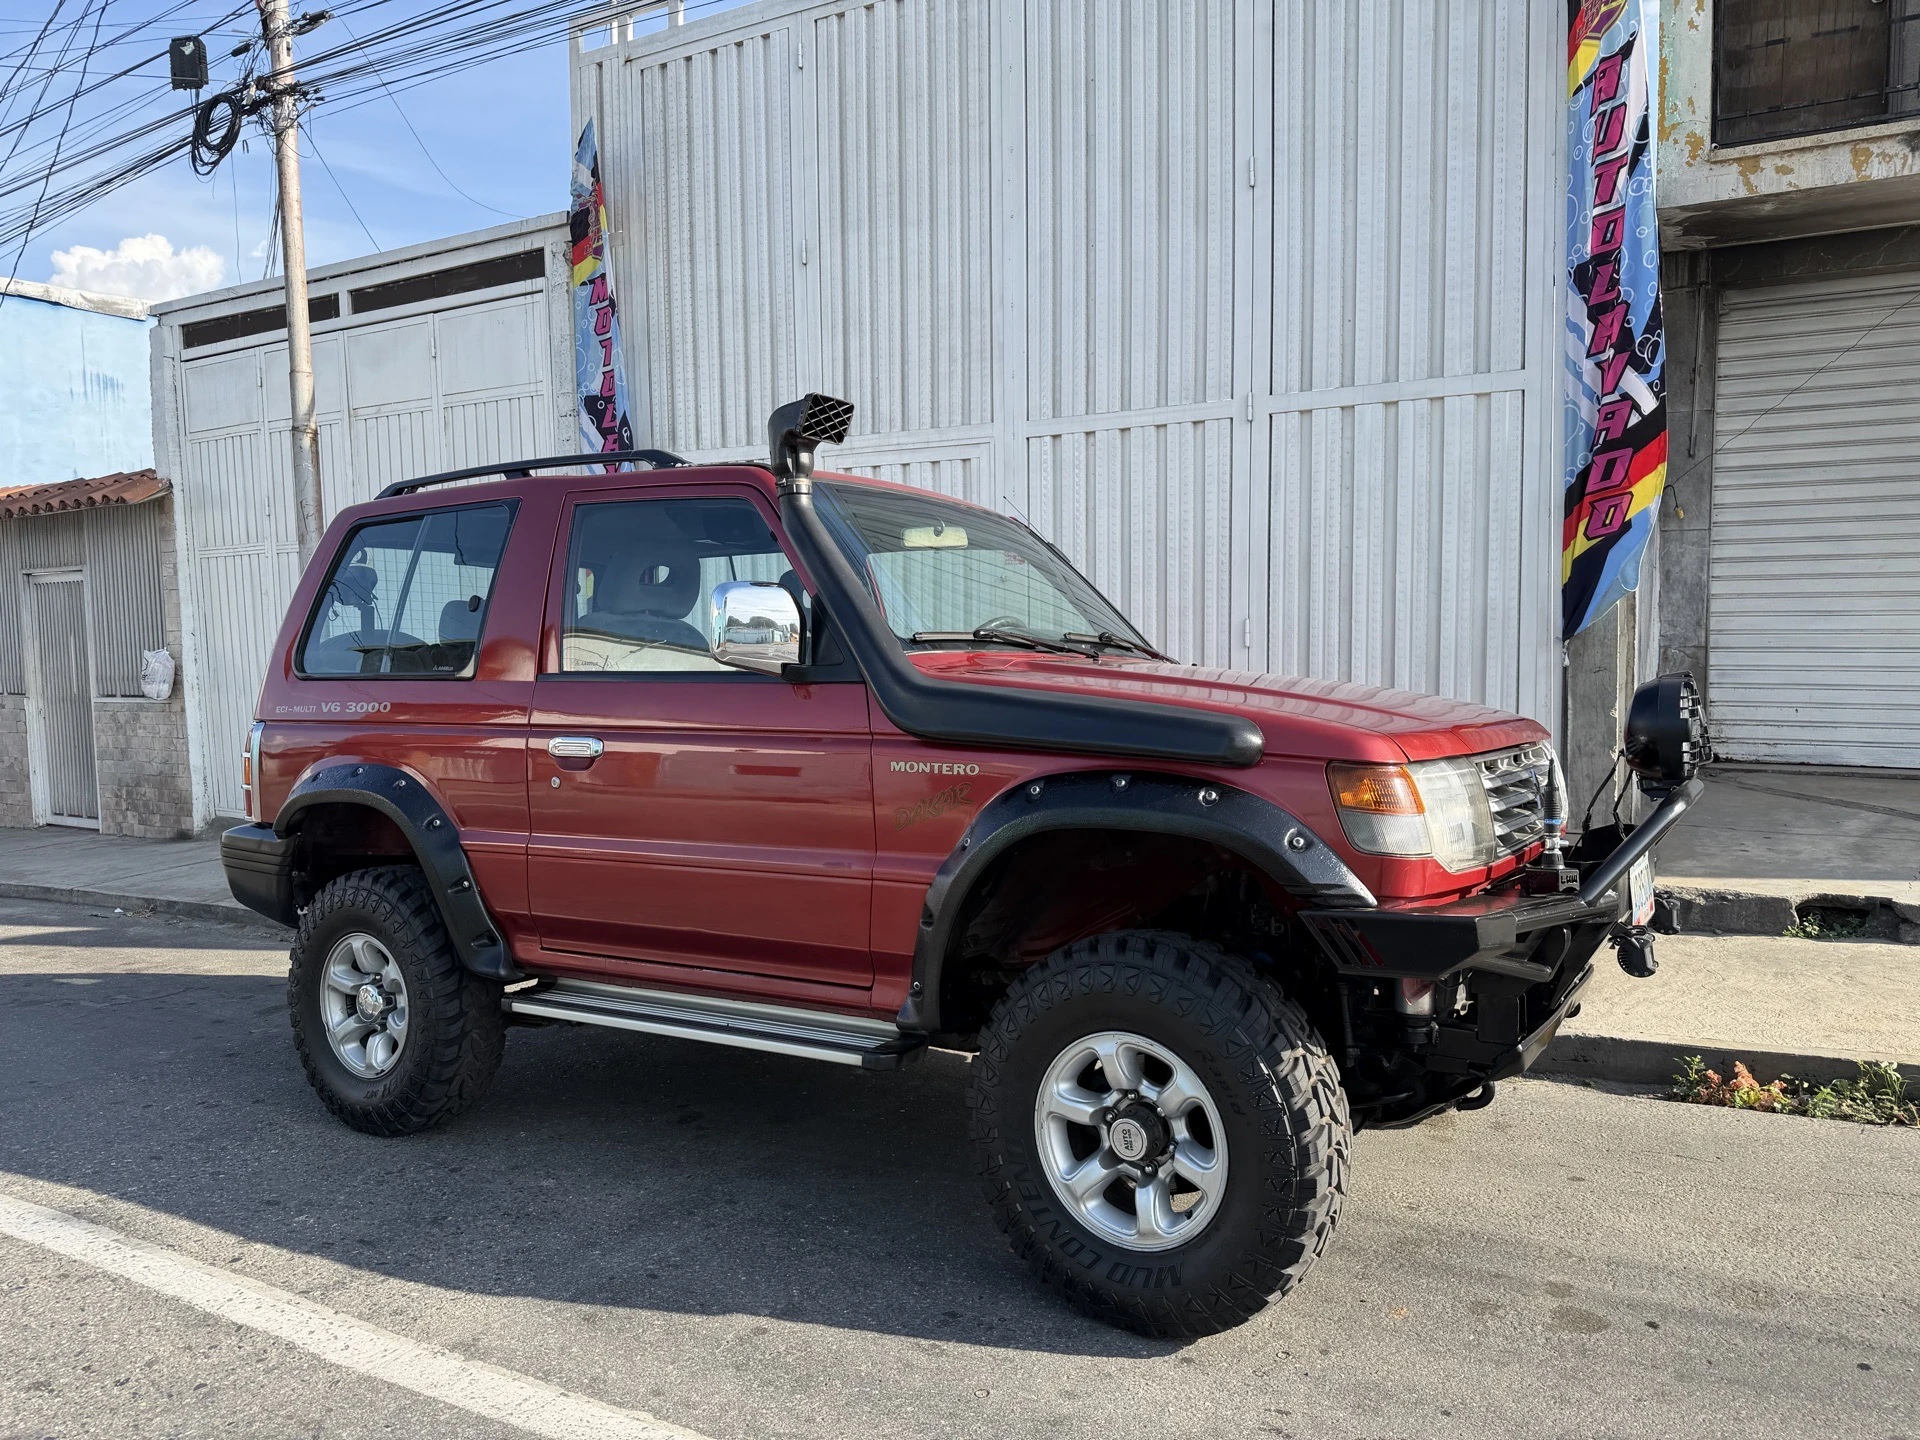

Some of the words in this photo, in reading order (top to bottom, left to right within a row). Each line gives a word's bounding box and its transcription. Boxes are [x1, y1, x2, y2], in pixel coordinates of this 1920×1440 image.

[1583, 54, 1634, 542] AUTOLAVADO
[275, 705, 316, 713] ECI-MULTI
[321, 702, 341, 713] V6
[345, 702, 391, 713] 3000
[890, 761, 980, 776] MONTERO
[1122, 1129, 1130, 1151] AUTO
[1106, 1260, 1184, 1290] MUD
